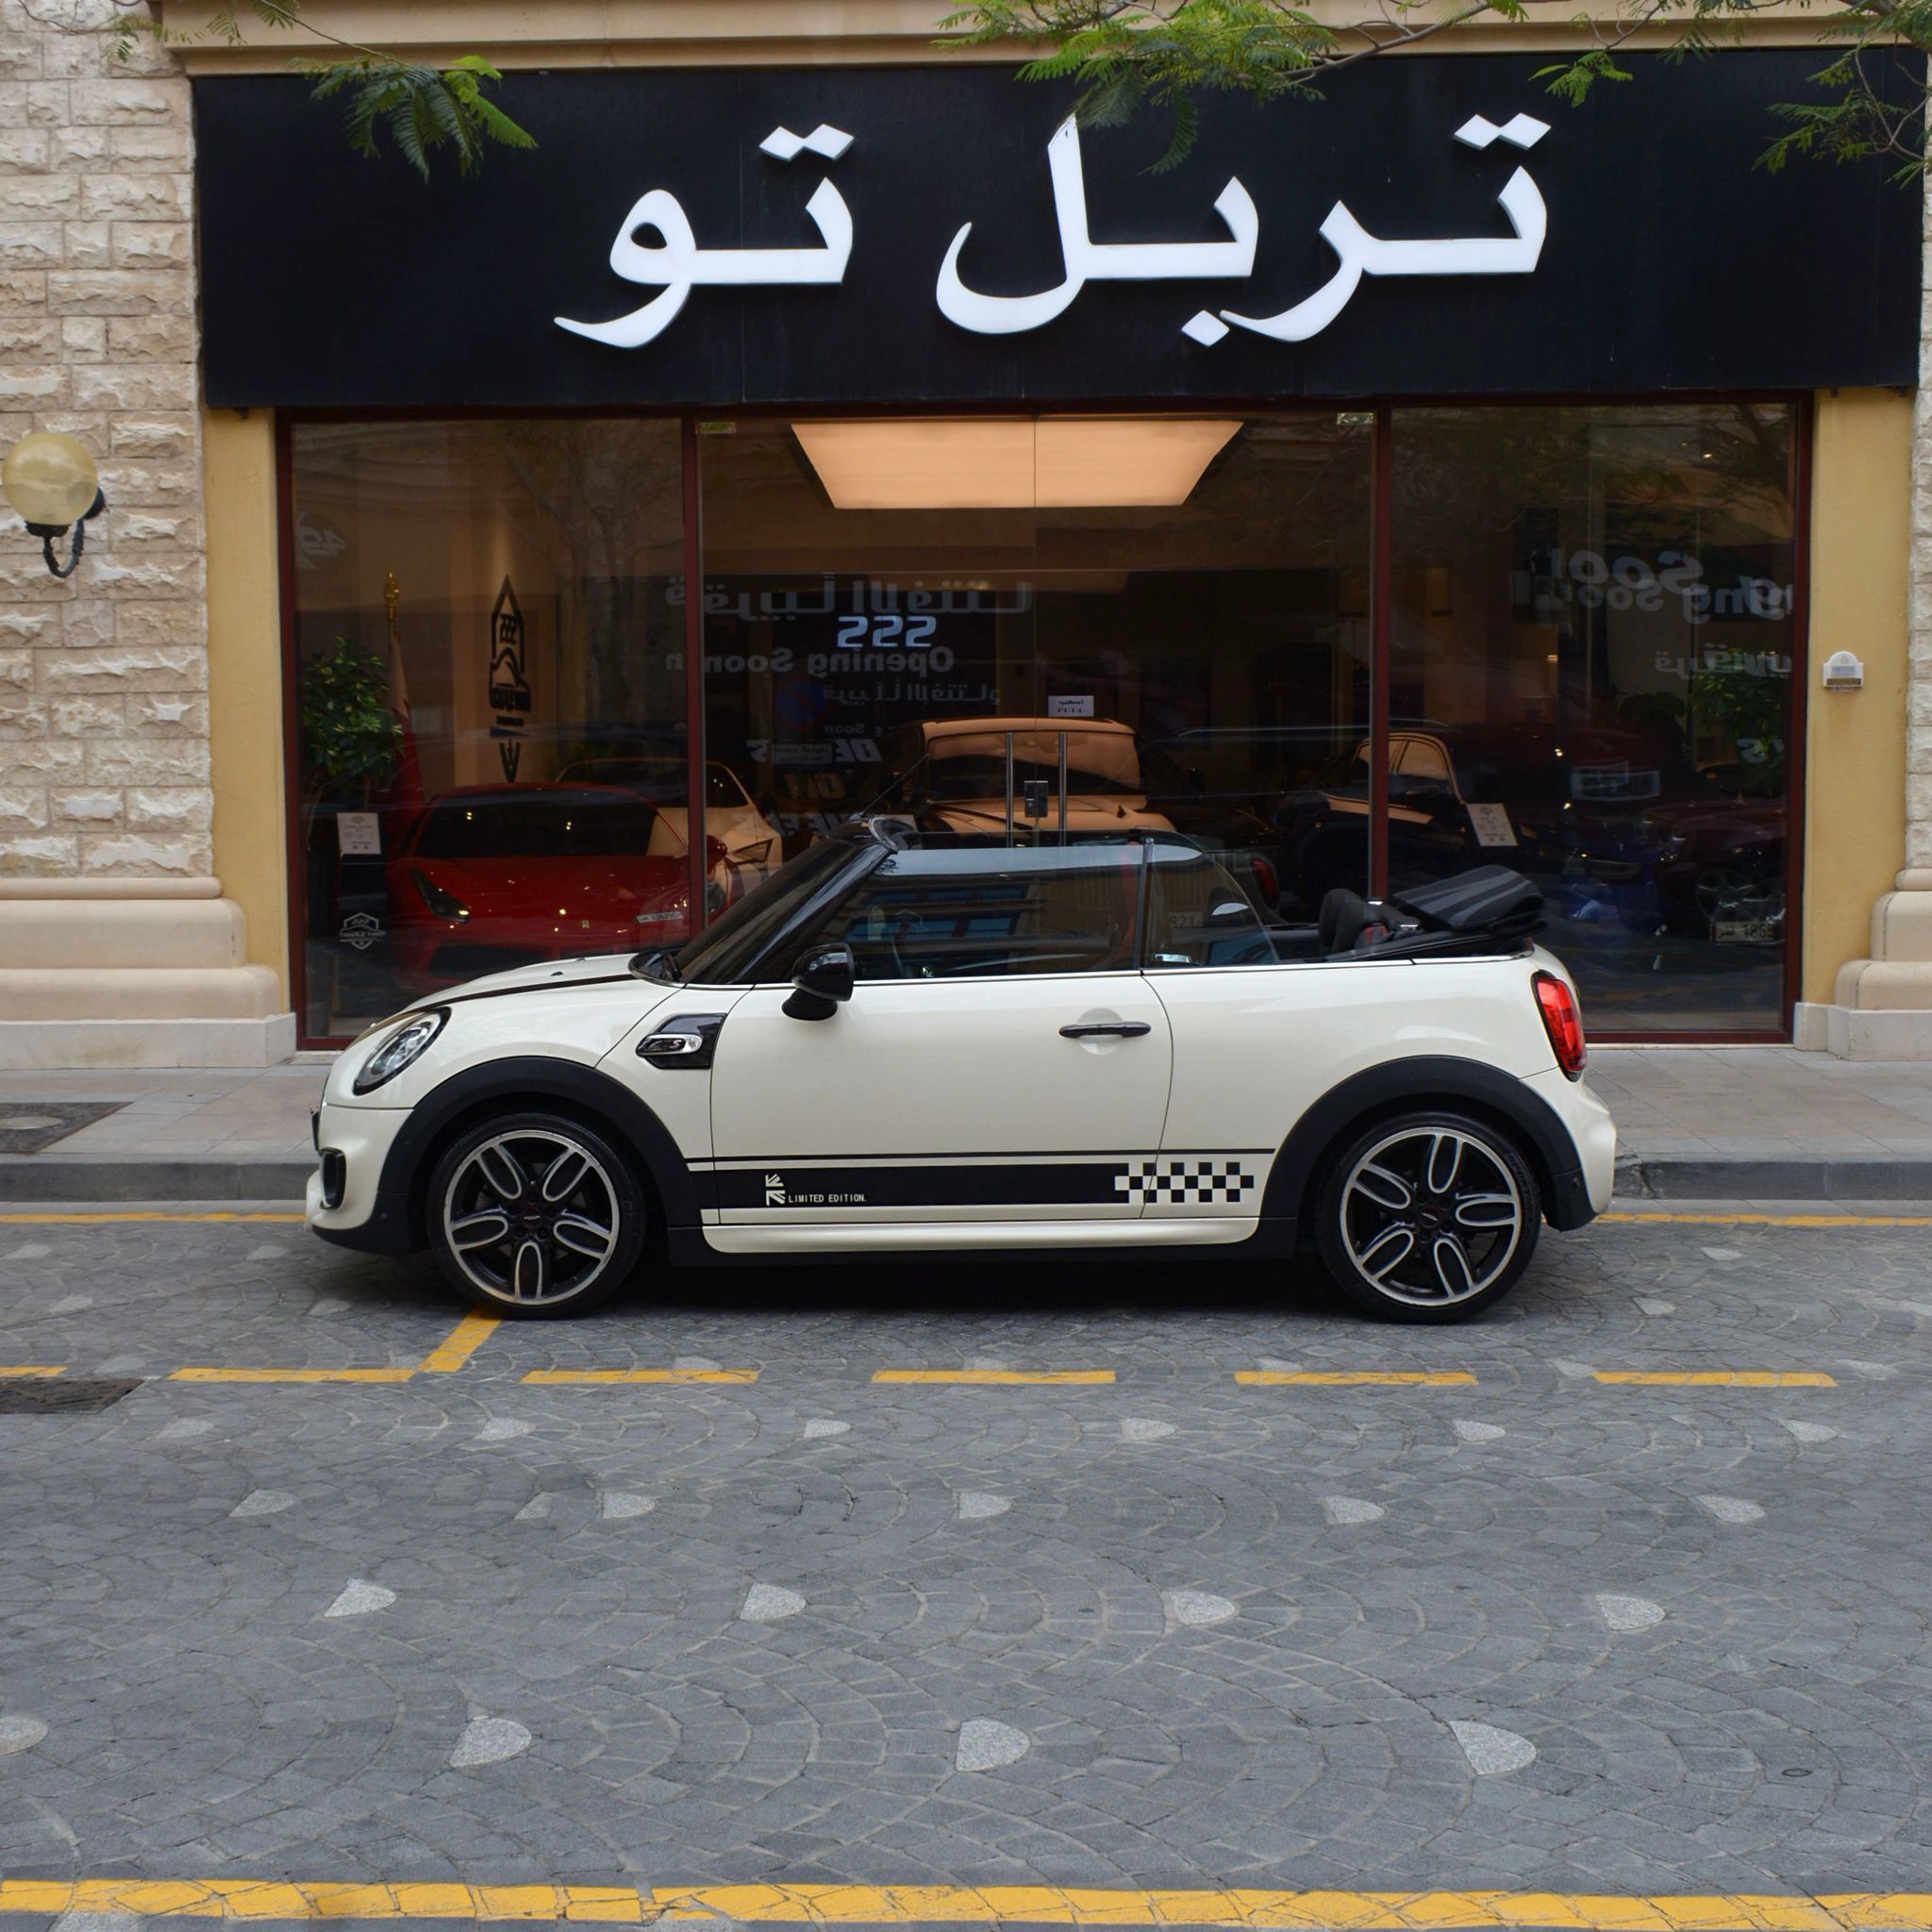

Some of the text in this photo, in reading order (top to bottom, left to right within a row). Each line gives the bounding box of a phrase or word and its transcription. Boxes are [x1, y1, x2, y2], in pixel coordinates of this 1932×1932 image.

[553, 111, 1553, 349] تربل تو
[789, 1194, 824, 1203] LIMITED
